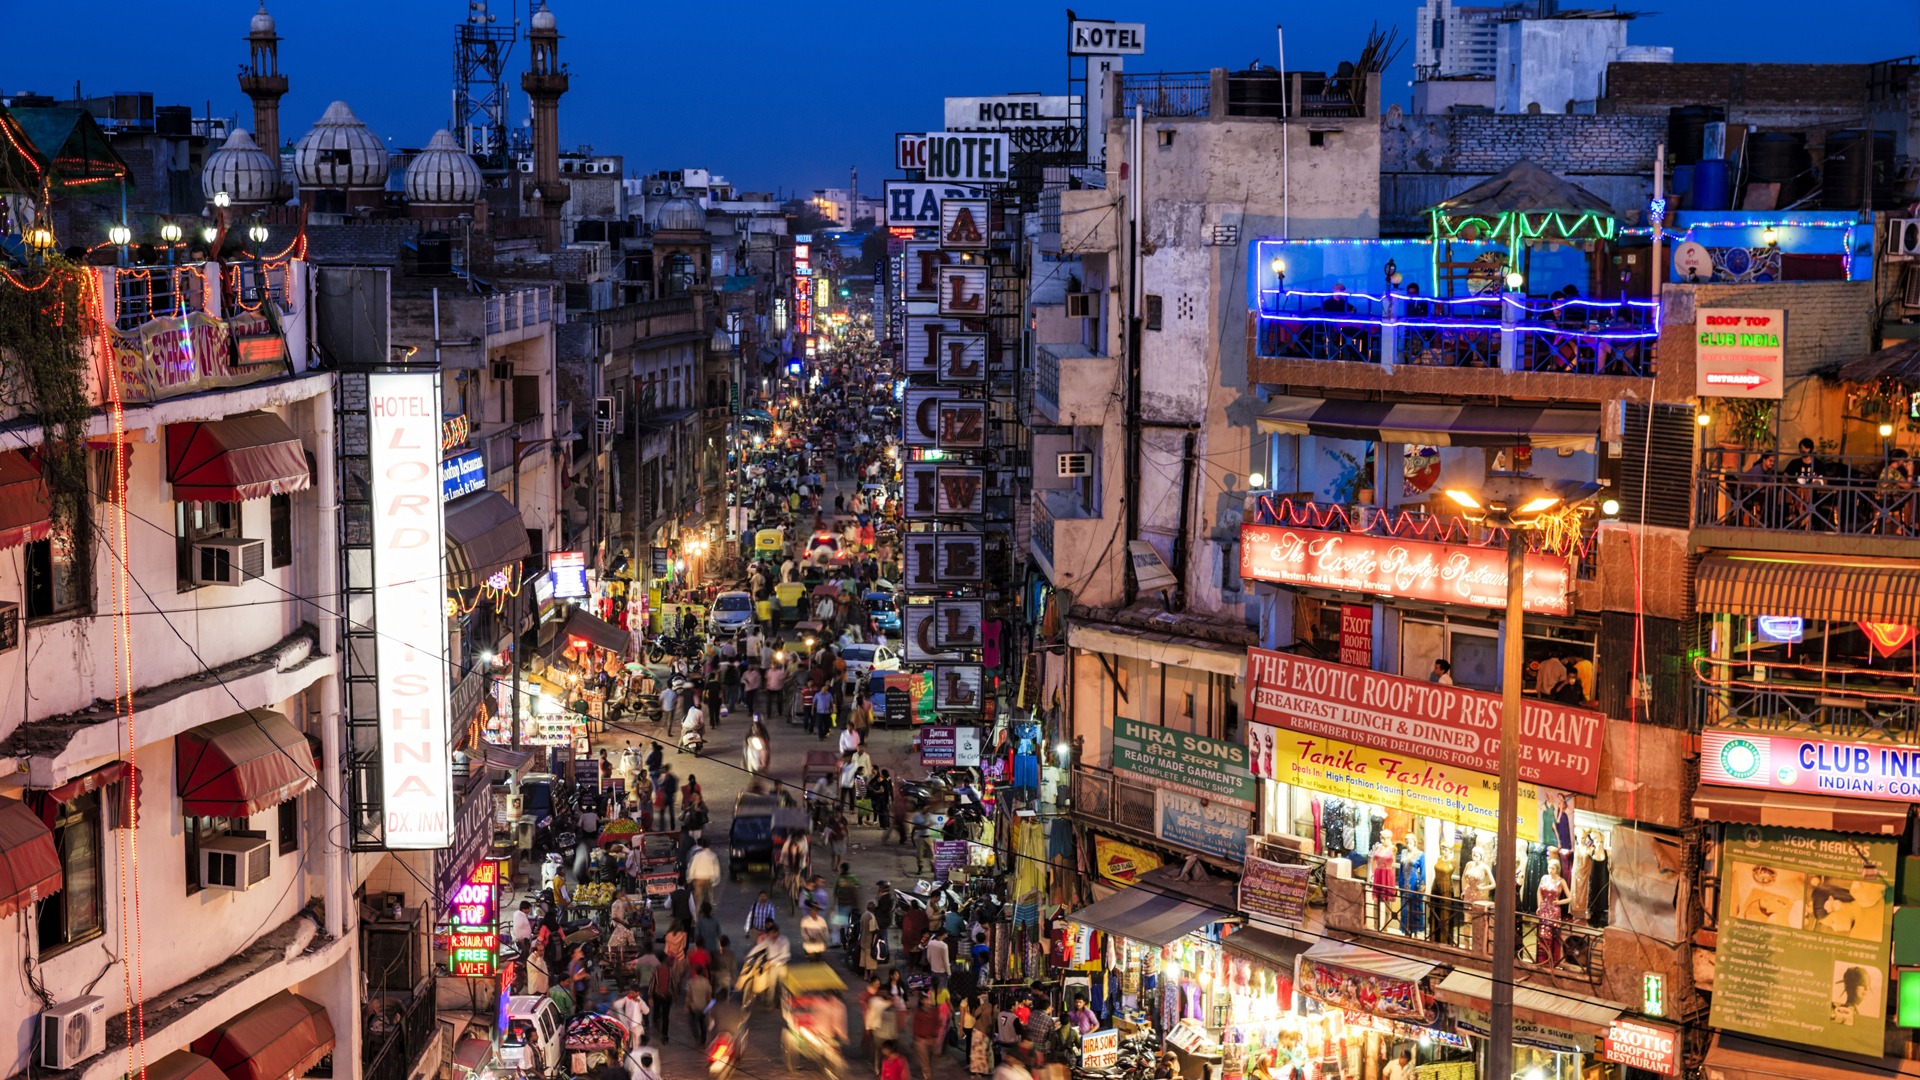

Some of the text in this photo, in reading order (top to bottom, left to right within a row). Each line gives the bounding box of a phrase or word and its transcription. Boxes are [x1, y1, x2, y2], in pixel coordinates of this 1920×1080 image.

[1076, 28, 1141, 48] HOTEL
[979, 102, 1044, 121] HOTEL
[928, 137, 1008, 178] HOTEL
[1706, 315, 1770, 327] ROOF TOP
[1699, 333, 1779, 347] CLUB INDIA
[1707, 375, 1760, 384] ENTRANCE
[374, 396, 429, 417] HOTEL
[1271, 532, 1533, 597] The Exotic Rooftop Restaurt
[1254, 567, 1280, 577] Delicious
[1281, 570, 1305, 580] Western
[1307, 573, 1322, 582] Food
[1323, 575, 1328, 583] &
[1363, 579, 1391, 591] Services
[1343, 607, 1351, 615] THE
[1252, 653, 1599, 750] THE EXOTIC ROOFTOP RESURANT
[1256, 690, 1474, 749] BREAKFAST LUNCH & DINNER
[929, 729, 948, 738] Дипак
[1126, 723, 1243, 762] HIRA SONS
[1146, 743, 1177, 758] हीरा
[1290, 716, 1540, 780] REMEMBER US FOR DELICIOUS FOOD SECES
[1124, 749, 1243, 787] READY MADE GARMENTS
[1297, 740, 1469, 797] Tanika Fashion
[1537, 747, 1590, 776] WI-FI)
[1799, 743, 1870, 774] CLUB
[1123, 770, 1163, 787] SUMMER
[1173, 783, 1210, 800] WINTER
[1213, 794, 1243, 807] WEAR
[1138, 764, 1179, 782] COMPLETE
[1182, 775, 1210, 790] FAMILY
[1212, 783, 1235, 795] SHOP
[1292, 762, 1311, 774] Deals
[1312, 767, 1322, 778] In:
[1325, 771, 1344, 784] High
[1345, 774, 1374, 790] Fashion
[1376, 781, 1404, 797] Sequins
[1406, 788, 1444, 806] Garments
[1445, 797, 1466, 813] Belly
[1467, 802, 1493, 817] Dance
[1482, 779, 1491, 789] M.
[1819, 775, 1873, 792] INDIAN
[471, 783, 492, 832] CAFE
[1163, 794, 1201, 816] HIRA
[1770, 845, 1811, 857] AYURVEDIC
[1814, 852, 1847, 862] THERAPY
[1783, 834, 1870, 858] VEDIC HEALERS
[1110, 861, 1134, 872] GOLD FLAKE
[459, 905, 485, 924] TOP
[452, 936, 493, 947] RSTAURNT
[457, 949, 488, 961] FREE
[1747, 959, 1757, 967] Oils
[460, 963, 487, 974] WI-FI
[1548, 1029, 1574, 1040] SILVER
[1622, 1022, 1649, 1033] WELCOME
[1083, 1034, 1117, 1054] HIRA SONS
[1609, 1028, 1672, 1054] EXOTIC
[1607, 1050, 1670, 1073] RESTAURANT
[1613, 1042, 1664, 1061] ROOFTOP
